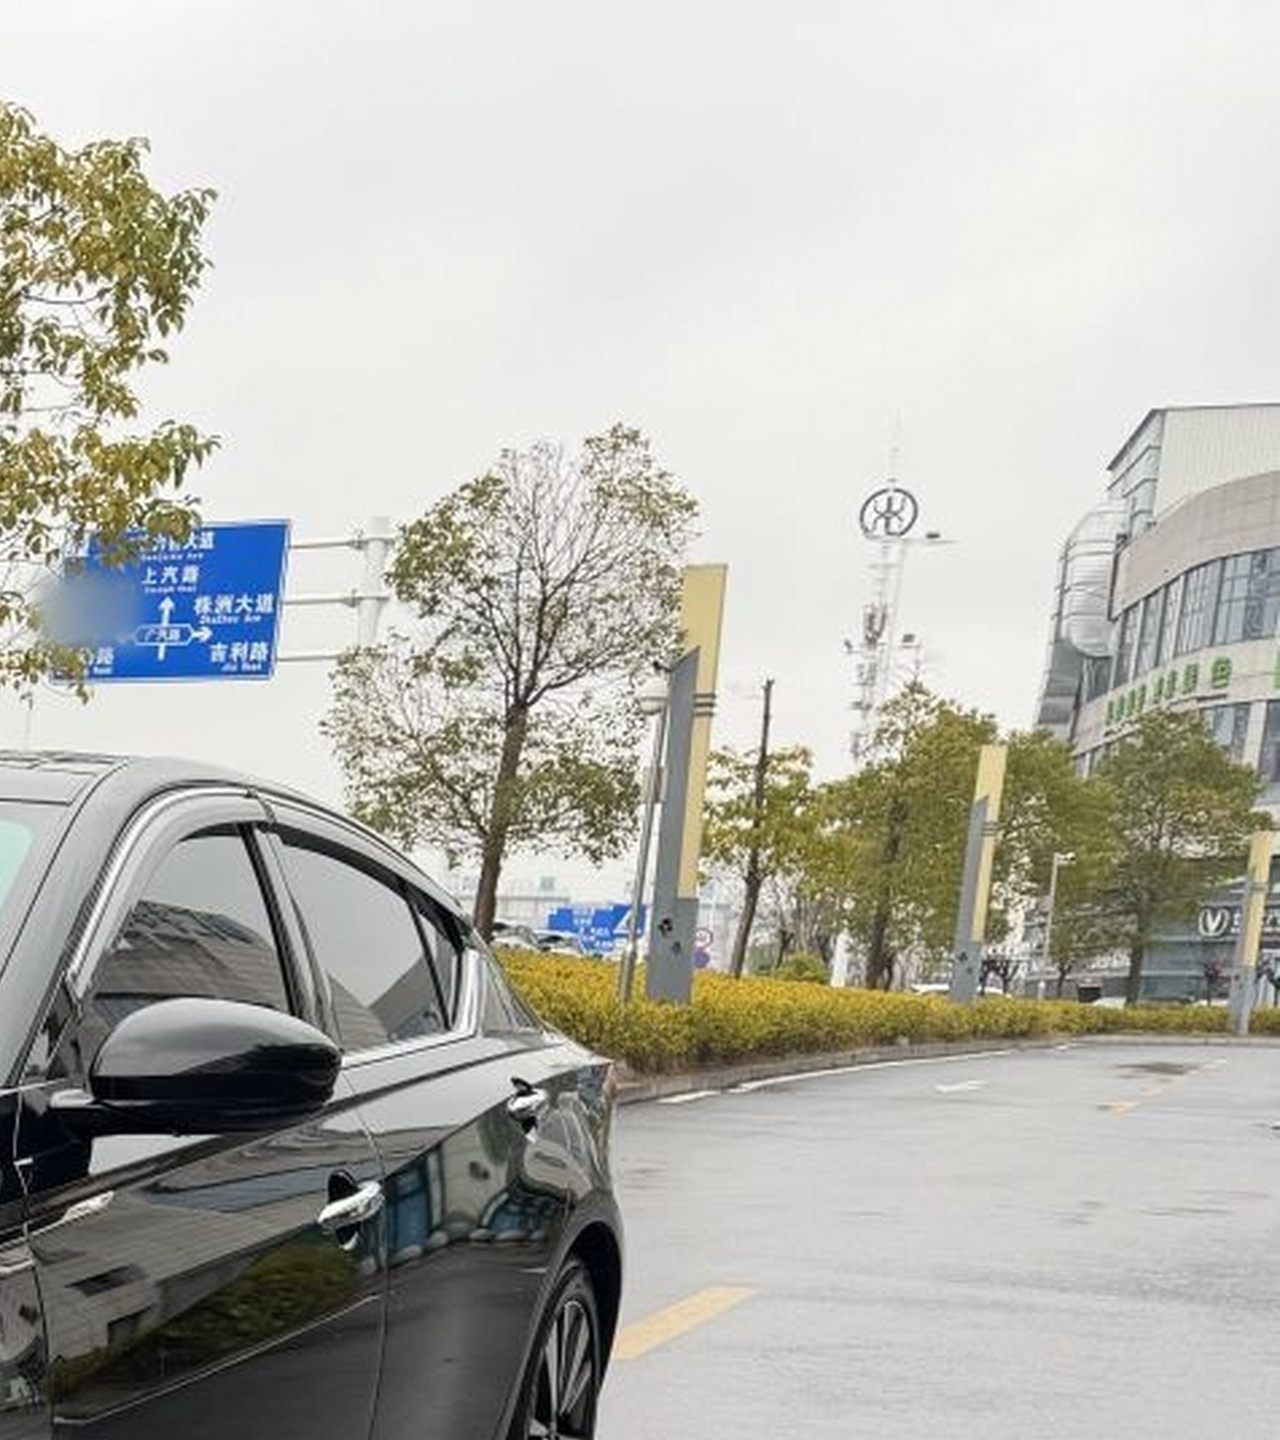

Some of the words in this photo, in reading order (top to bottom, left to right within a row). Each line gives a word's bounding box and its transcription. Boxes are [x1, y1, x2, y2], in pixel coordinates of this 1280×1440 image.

[142, 566, 199, 584] 上汽路
[194, 594, 274, 615] 株洲大道
[210, 642, 269, 663] 吉利路
